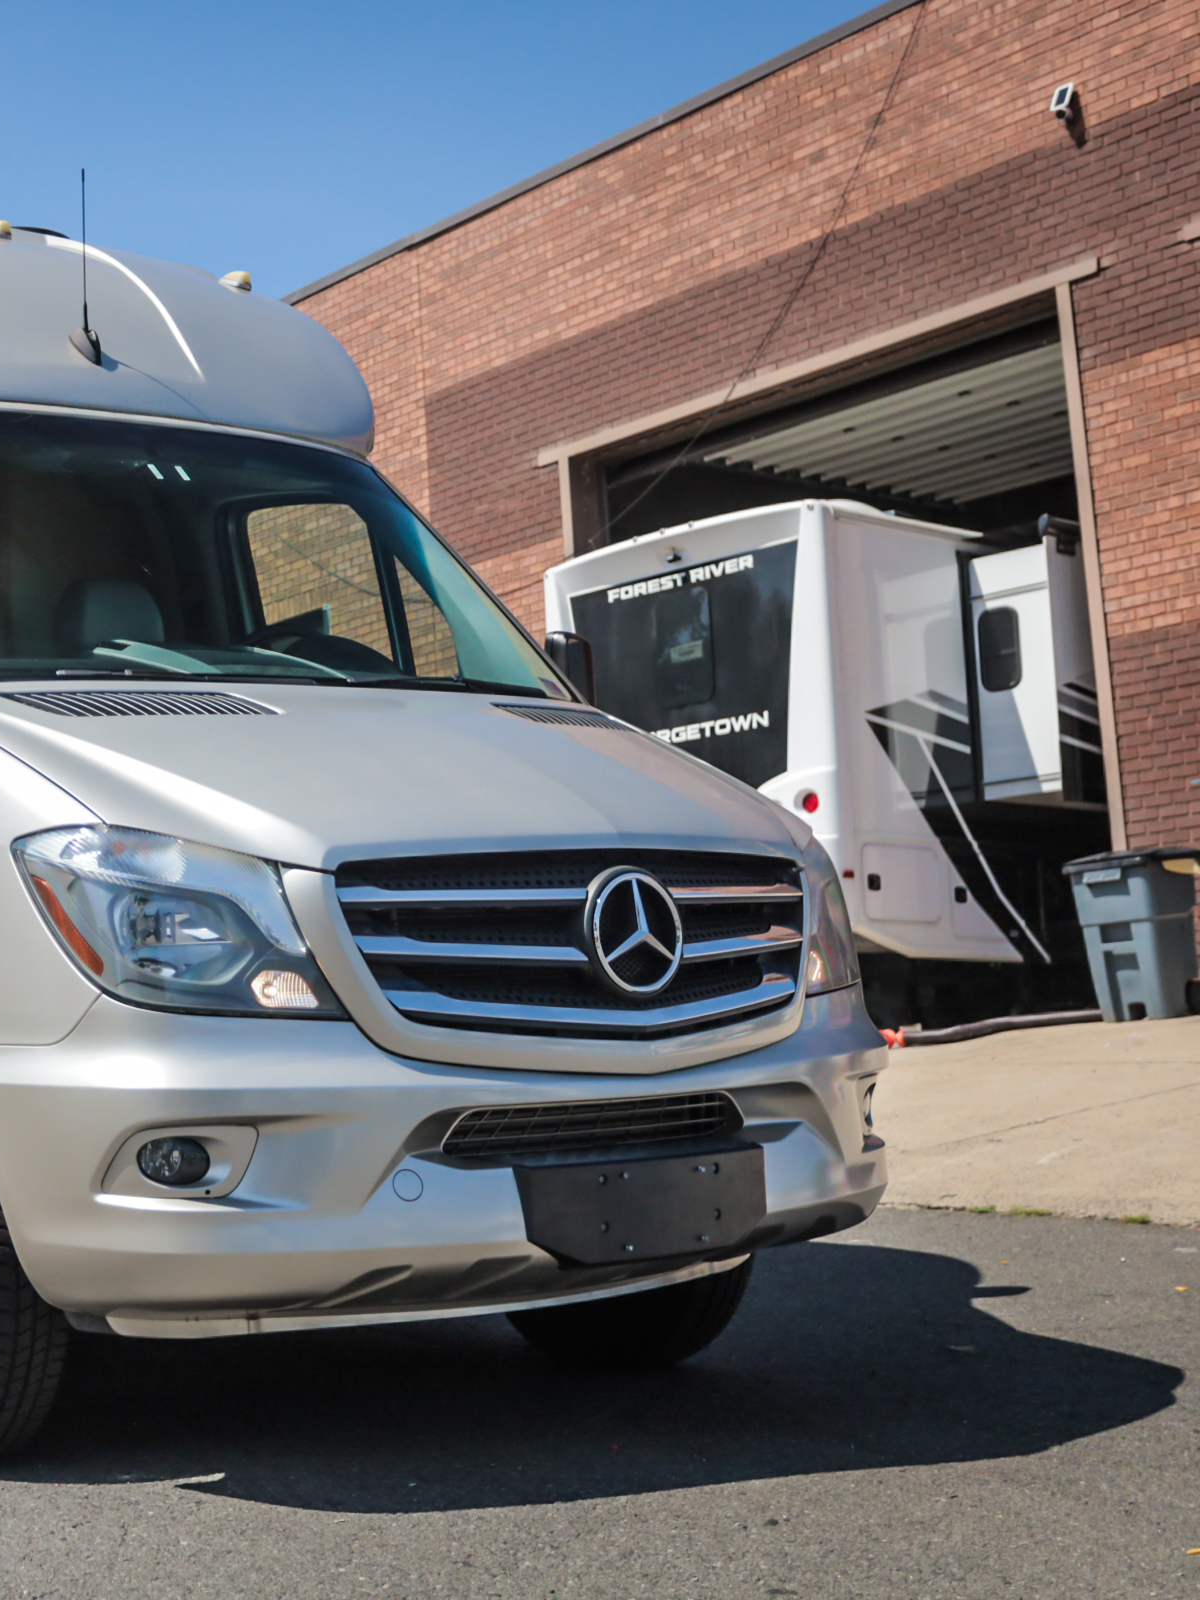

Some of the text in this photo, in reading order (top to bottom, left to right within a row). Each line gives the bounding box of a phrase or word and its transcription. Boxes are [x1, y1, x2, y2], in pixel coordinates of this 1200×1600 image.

[607, 554, 755, 604] FOREST RIVER
[650, 710, 770, 744] RGETOWN
